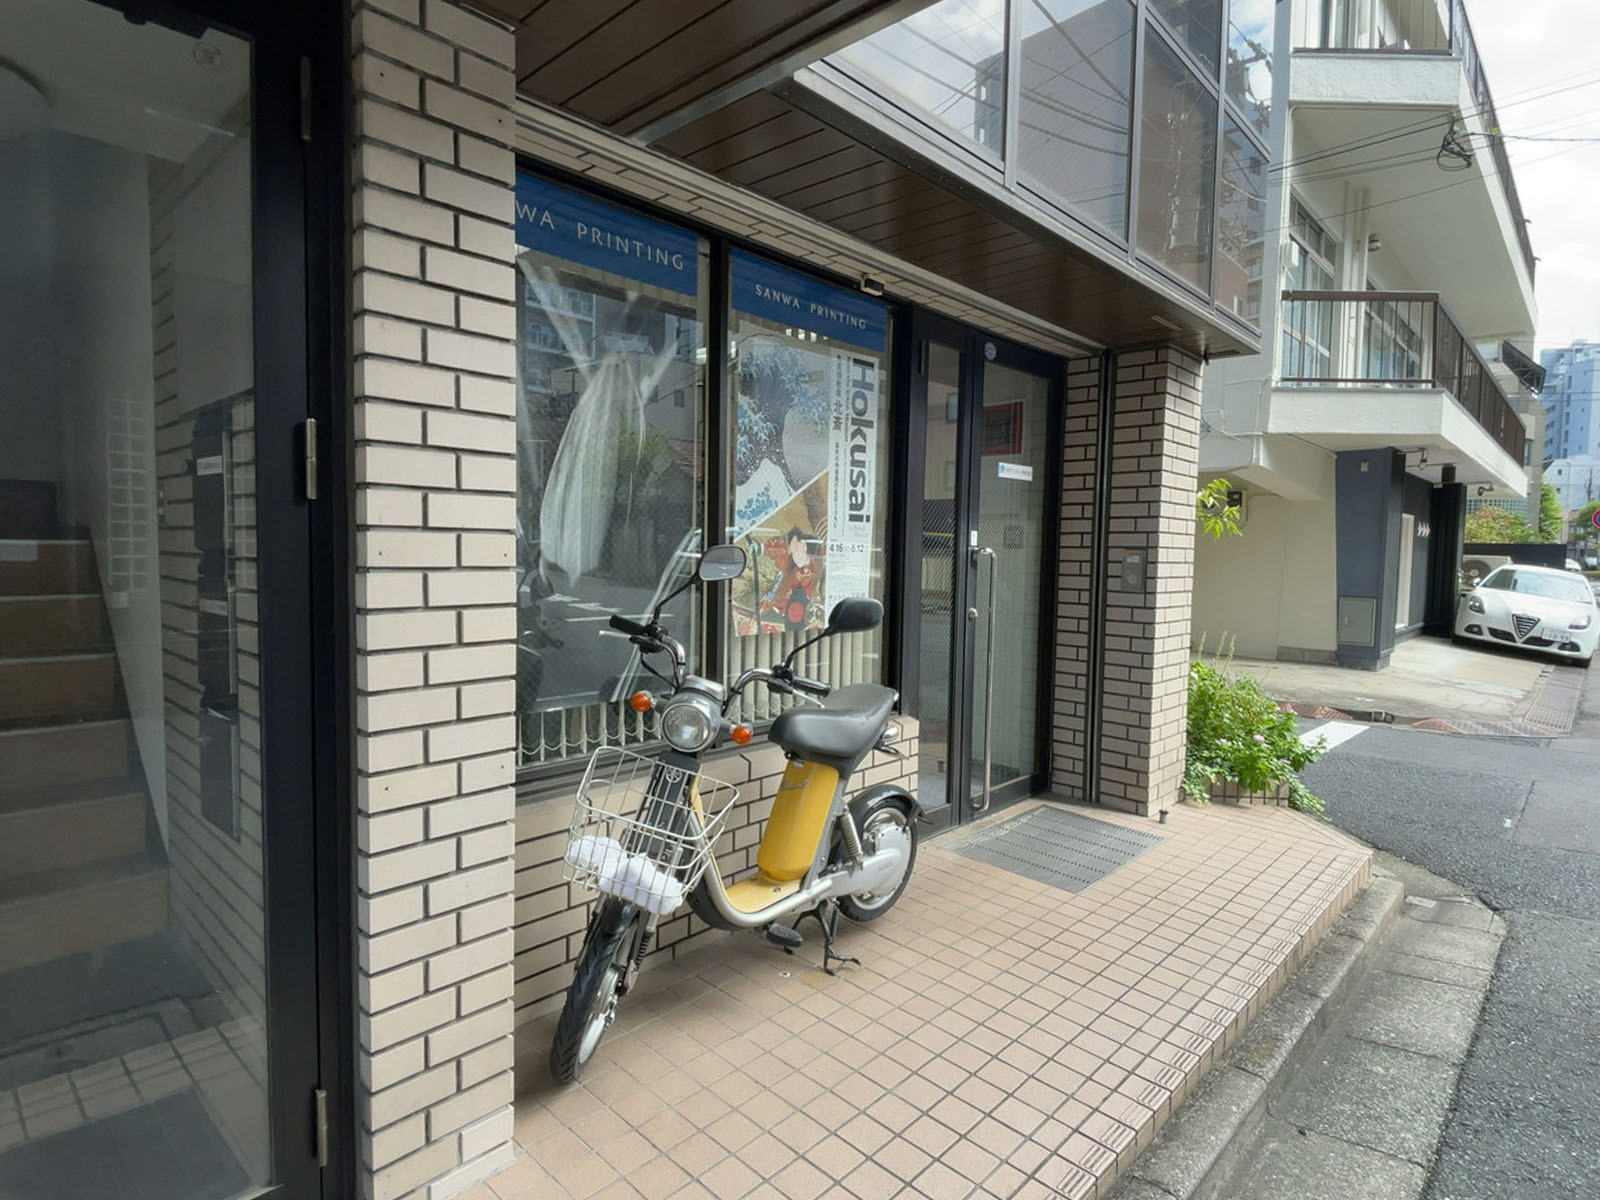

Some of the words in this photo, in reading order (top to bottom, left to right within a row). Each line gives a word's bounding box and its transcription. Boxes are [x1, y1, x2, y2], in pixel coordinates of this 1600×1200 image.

[577, 222, 684, 271] PRINTING
[755, 284, 800, 310] SANWA
[810, 303, 867, 330] PRINTING
[849, 357, 875, 524] Hokusai
